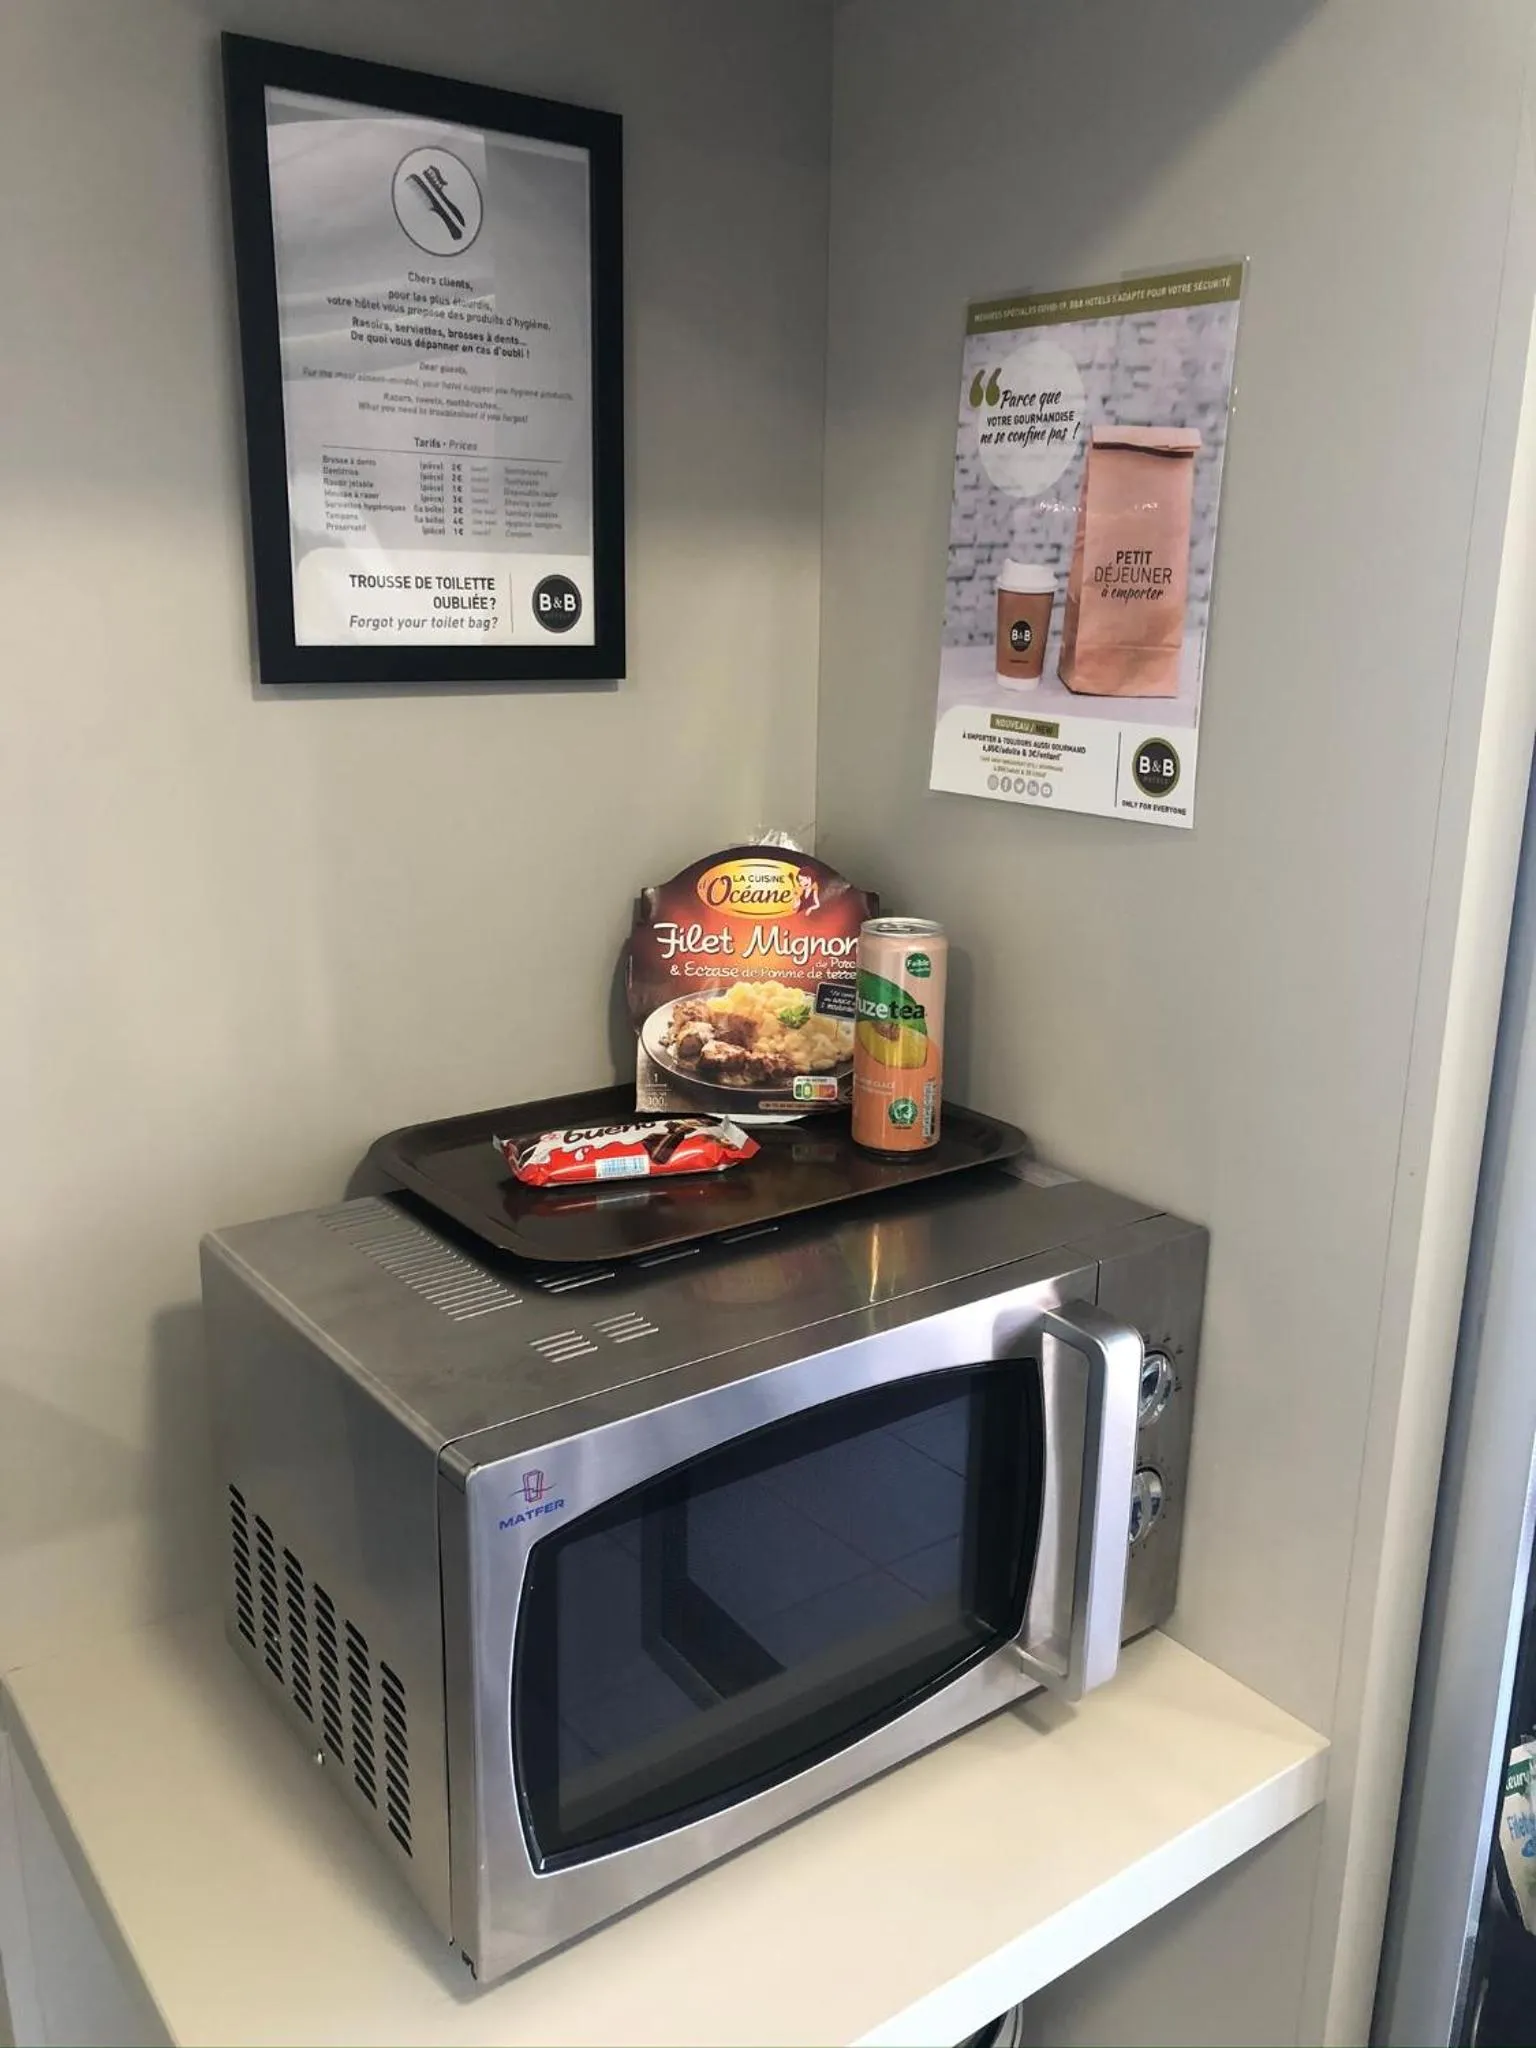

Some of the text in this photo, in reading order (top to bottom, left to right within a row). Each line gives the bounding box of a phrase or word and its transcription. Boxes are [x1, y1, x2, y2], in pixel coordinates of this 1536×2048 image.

[407, 270, 474, 291] Chers clients,
[1168, 283, 1191, 296] VOTRE
[388, 290, 411, 302] pour
[413, 291, 427, 303] les
[429, 294, 450, 306] plus
[326, 296, 352, 307] votre
[354, 297, 381, 310] hôtel
[382, 302, 406, 314] vous
[407, 305, 446, 319] propose
[447, 308, 465, 321] des
[466, 311, 505, 325] produits
[351, 316, 394, 333] Rasoirs,
[447, 327, 485, 343] brosses
[486, 331, 493, 343] à
[350, 329, 364, 342] De
[366, 333, 388, 345] quoi
[389, 336, 412, 348] vous
[414, 337, 460, 351] dépanner
[461, 343, 474, 353] en
[475, 343, 492, 356] cas
[1000, 389, 1062, 413] Parce que
[987, 410, 1076, 427] VOTRE GOURMANDISE
[413, 436, 479, 452] Tarifs Prices
[980, 431, 993, 445] ne
[994, 430, 1006, 446] se
[1007, 424, 1047, 449] confine
[1047, 426, 1068, 447] pas
[1116, 550, 1153, 565] PETIT
[349, 574, 496, 592] TROUSSE DE TOILETTE
[1094, 562, 1173, 585] DÉJEUNER
[539, 593, 577, 612] B&B
[1101, 583, 1164, 606] à emporter
[349, 614, 499, 633] Forgot your toilet bag?
[1139, 755, 1175, 777] B&B
[1139, 802, 1152, 811] FOR
[1153, 804, 1187, 816] EVERYONE
[732, 874, 785, 884] LA CUISINE
[706, 875, 794, 907] Océane
[653, 922, 734, 960] Filet
[670, 963, 681, 976] &
[806, 966, 823, 979] de
[825, 967, 858, 980] terre
[830, 956, 857, 969] Porc
[563, 1119, 656, 1145] bueno
[498, 1498, 565, 1531] MATFER
